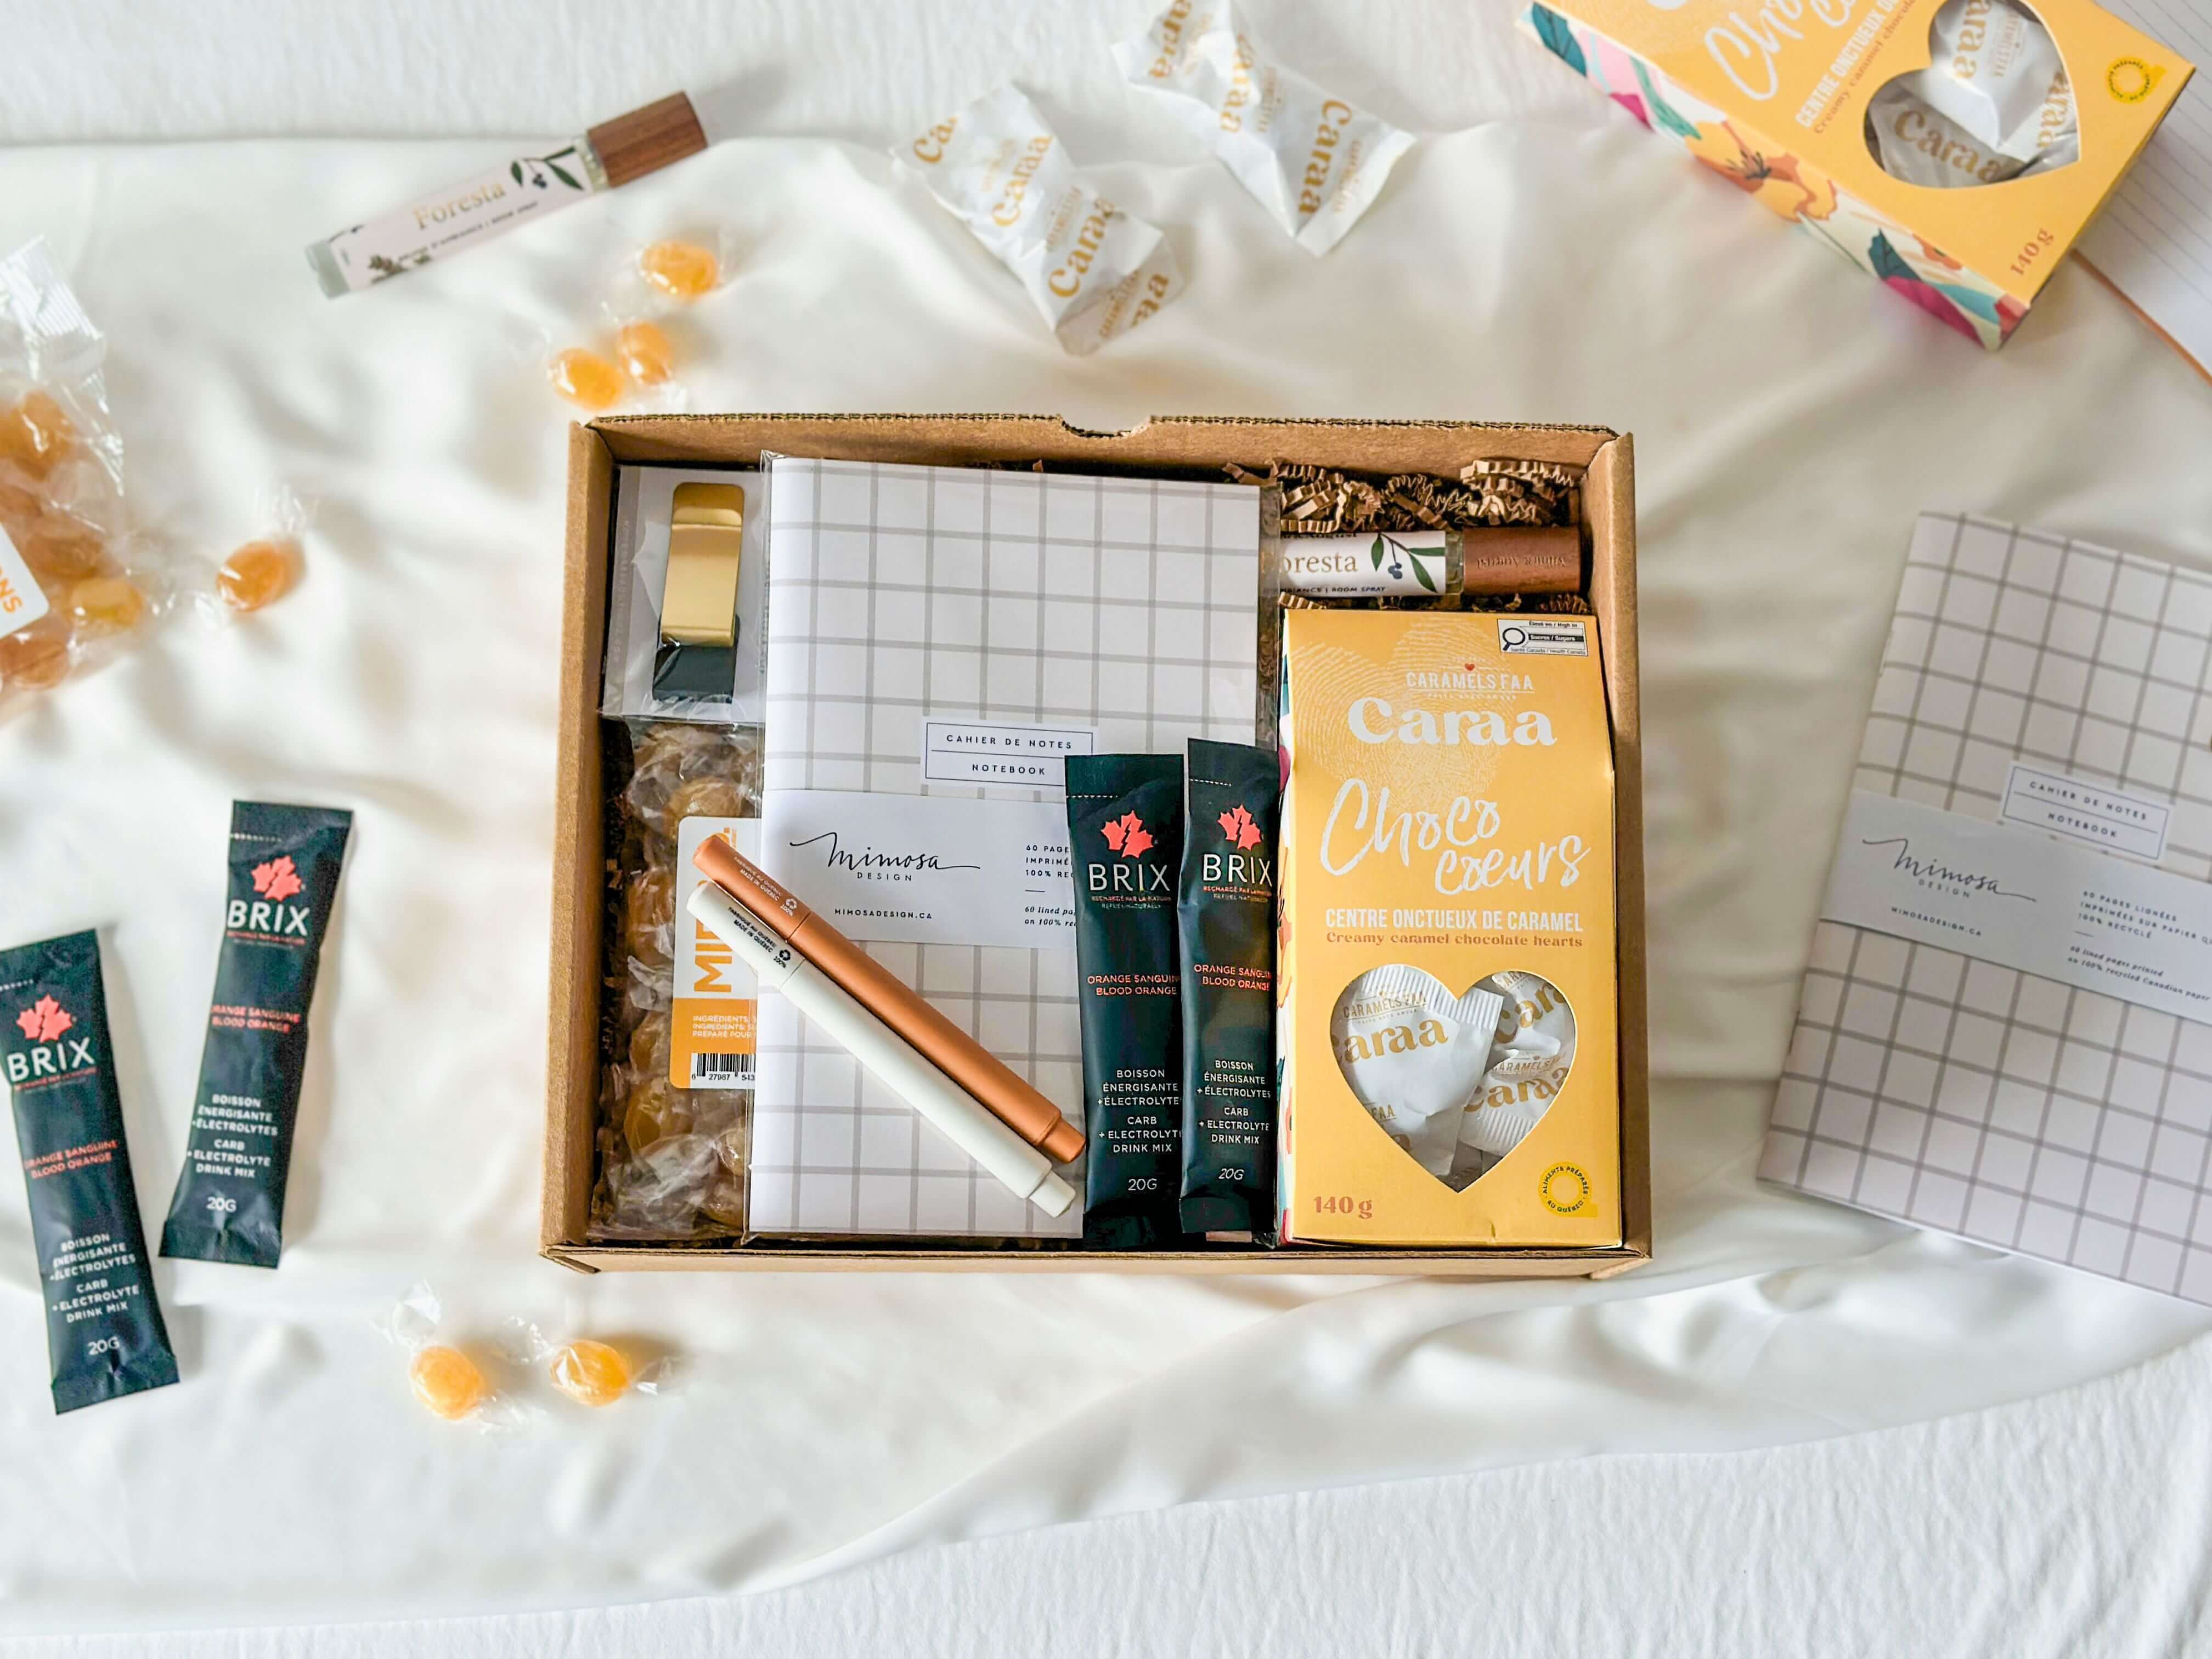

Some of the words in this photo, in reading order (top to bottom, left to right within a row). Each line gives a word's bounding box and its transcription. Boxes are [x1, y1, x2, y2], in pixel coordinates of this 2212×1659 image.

[1796, 73, 1840, 127] CENTRE
[1830, 9, 1886, 78] ONCTUEUX
[1814, 91, 1852, 134] Creamy
[1299, 99, 1352, 215] Caraa
[991, 135, 1054, 227] Caraa
[413, 183, 506, 230] Foresta
[2010, 244, 2040, 276] 140
[2036, 227, 2054, 246] g
[1406, 672, 1497, 690] CARAMELS
[1500, 674, 1534, 690] FAA
[1347, 696, 1558, 747] Caraa
[946, 735, 996, 744] CAHIER
[1029, 740, 1071, 749] NOTES
[972, 764, 1045, 775] NOTEBOOK
[2029, 781, 2076, 799] CAHIER
[2084, 797, 2098, 806] DE
[2106, 803, 2147, 821] NOTES
[1320, 778, 1500, 876] Choco
[2048, 812, 2117, 838] NOTEBOOK
[1026, 857, 1072, 865] IMPRIMÉ
[857, 872, 912, 882] DESIGN
[1088, 864, 1170, 891] BRIX
[1203, 854, 1272, 887] BRIX
[1919, 879, 1970, 899] DESIGN
[1038, 906, 1060, 915] lined
[2100, 895, 2130, 909] PAGES
[228, 900, 310, 936] BRIX
[834, 908, 933, 919] MIMOSADESIGN.CA
[1325, 909, 1387, 928] CENTRE
[1393, 909, 1477, 930] ONCTUEUX
[1483, 911, 1502, 930] DE
[1508, 912, 1583, 933] CARAMEL
[1892, 907, 1982, 936] MIMOSADESIGN.CA
[733, 919, 748, 933] MADE
[2108, 922, 2151, 939] RECYCLÉ
[2140, 918, 2157, 928] SUR
[2163, 925, 2196, 939] PAPIER
[1326, 932, 1384, 946] Creamy
[1391, 933, 1449, 945] caramel
[1454, 934, 1528, 946] chocolate
[1533, 935, 1583, 948] hearts
[1194, 964, 1236, 975] ORANGE
[2106, 957, 2130, 967] pages
[1087, 975, 1131, 984] ORANGE
[1202, 976, 1235, 987] BLOOD
[2106, 967, 2140, 982] recycled
[2143, 978, 2183, 994] Canadian
[2186, 990, 2210, 1001] paper
[1096, 987, 1132, 996] BLOOD
[1342, 997, 1402, 1019] CARAMELS
[212, 1016, 246, 1028] BLOOD
[247, 1019, 290, 1034] ORANGE
[1339, 1019, 1449, 1064] araa
[7, 1036, 95, 1082] BRIX
[1215, 1060, 1254, 1070] BOISSON
[1116, 1070, 1165, 1078] BOISSON
[1204, 1071, 1265, 1085] ÉNERGISANTE
[1103, 1082, 1178, 1092] ÉNERGISANTE
[212, 1094, 262, 1108] BOISSON
[198, 1104, 273, 1123] ÉNERGISANTE
[1224, 1107, 1249, 1116] CARB
[1127, 1116, 1157, 1125] CARB
[1207, 1120, 1269, 1131] ELECTROLYTE
[214, 1138, 245, 1151] CARB
[1211, 1135, 1241, 1144] DRINK
[1244, 1135, 1260, 1144] MIX
[1113, 1144, 1148, 1153] DRINK
[1153, 1144, 1172, 1152] MIX
[31, 1163, 65, 1179] BLOOD
[67, 1152, 112, 1169] ORANGE
[193, 1149, 271, 1167] ELECTROLYTE
[196, 1163, 231, 1176] DRINK
[235, 1164, 255, 1178] MIX
[1218, 1168, 1244, 1180] 20G
[1128, 1178, 1157, 1190] 20G
[206, 1197, 236, 1212] 20G
[1313, 1196, 1354, 1214] 140
[1359, 1199, 1372, 1219] g
[61, 1233, 110, 1252] BOISSON
[76, 1279, 108, 1294] CARB
[59, 1285, 139, 1311] ELECTROLYTE
[66, 1306, 103, 1323] DRINK
[106, 1301, 128, 1314] MIX
[88, 1336, 120, 1356] 20G
